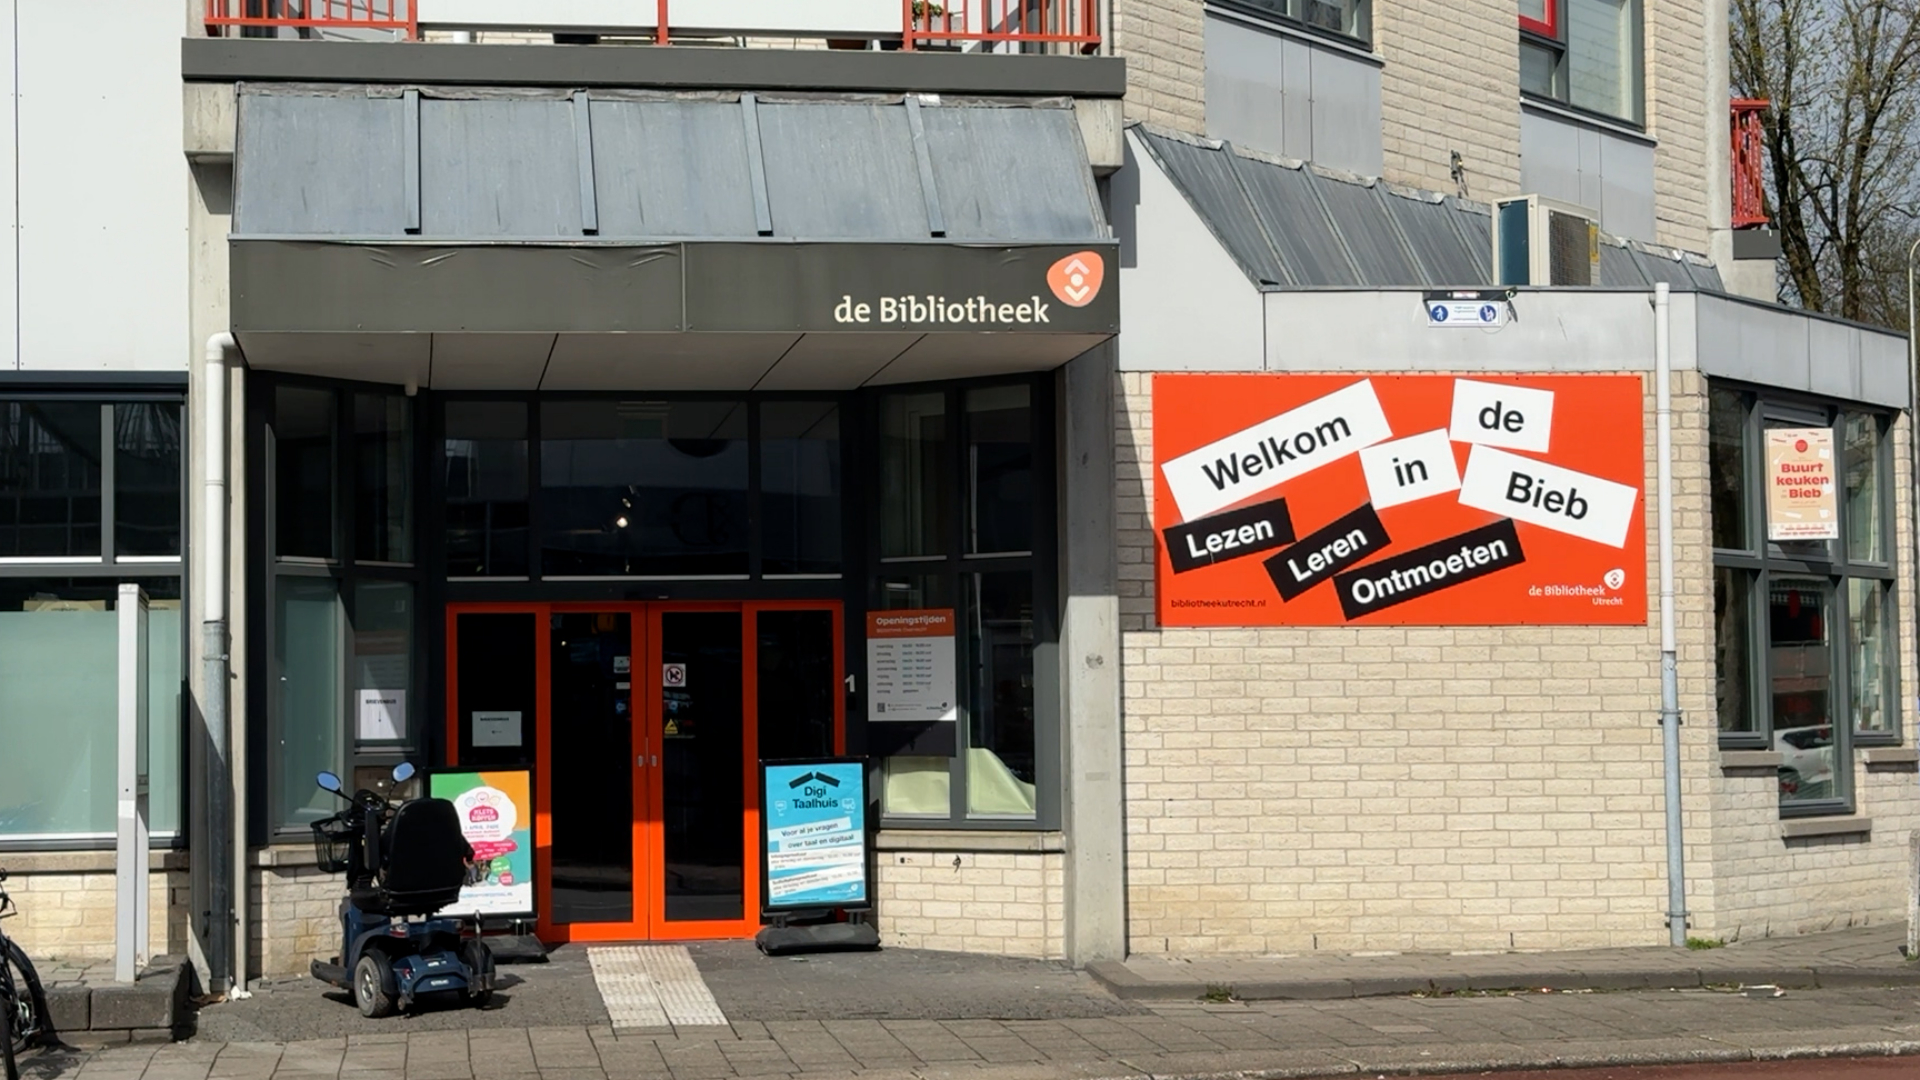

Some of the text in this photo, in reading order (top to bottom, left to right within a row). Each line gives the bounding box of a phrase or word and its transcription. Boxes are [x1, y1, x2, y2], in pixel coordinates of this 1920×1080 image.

[834, 296, 1050, 323] de Bibliotheek
[1202, 401, 1589, 520] Welkom in de Bieb
[1781, 463, 1824, 473] Buurt
[1776, 476, 1830, 486] keuken
[1789, 488, 1822, 499] Bieb
[1186, 517, 1274, 559] Lezen
[1287, 524, 1368, 582] Leren
[1351, 537, 1509, 605] Ontmoeten
[1528, 585, 1606, 596] de Bibliotheek
[1170, 599, 1267, 608] bibliotheekutrecht.nl
[1592, 597, 1624, 606] Utrecht
[876, 615, 946, 626] Openingstijden
[844, 673, 856, 693] 1
[804, 785, 827, 798] Digi
[792, 798, 839, 809] Taalhuis
[781, 828, 798, 837] Voor
[807, 826, 814, 834] je
[815, 822, 838, 832] vragen
[829, 834, 854, 843] digitaal
